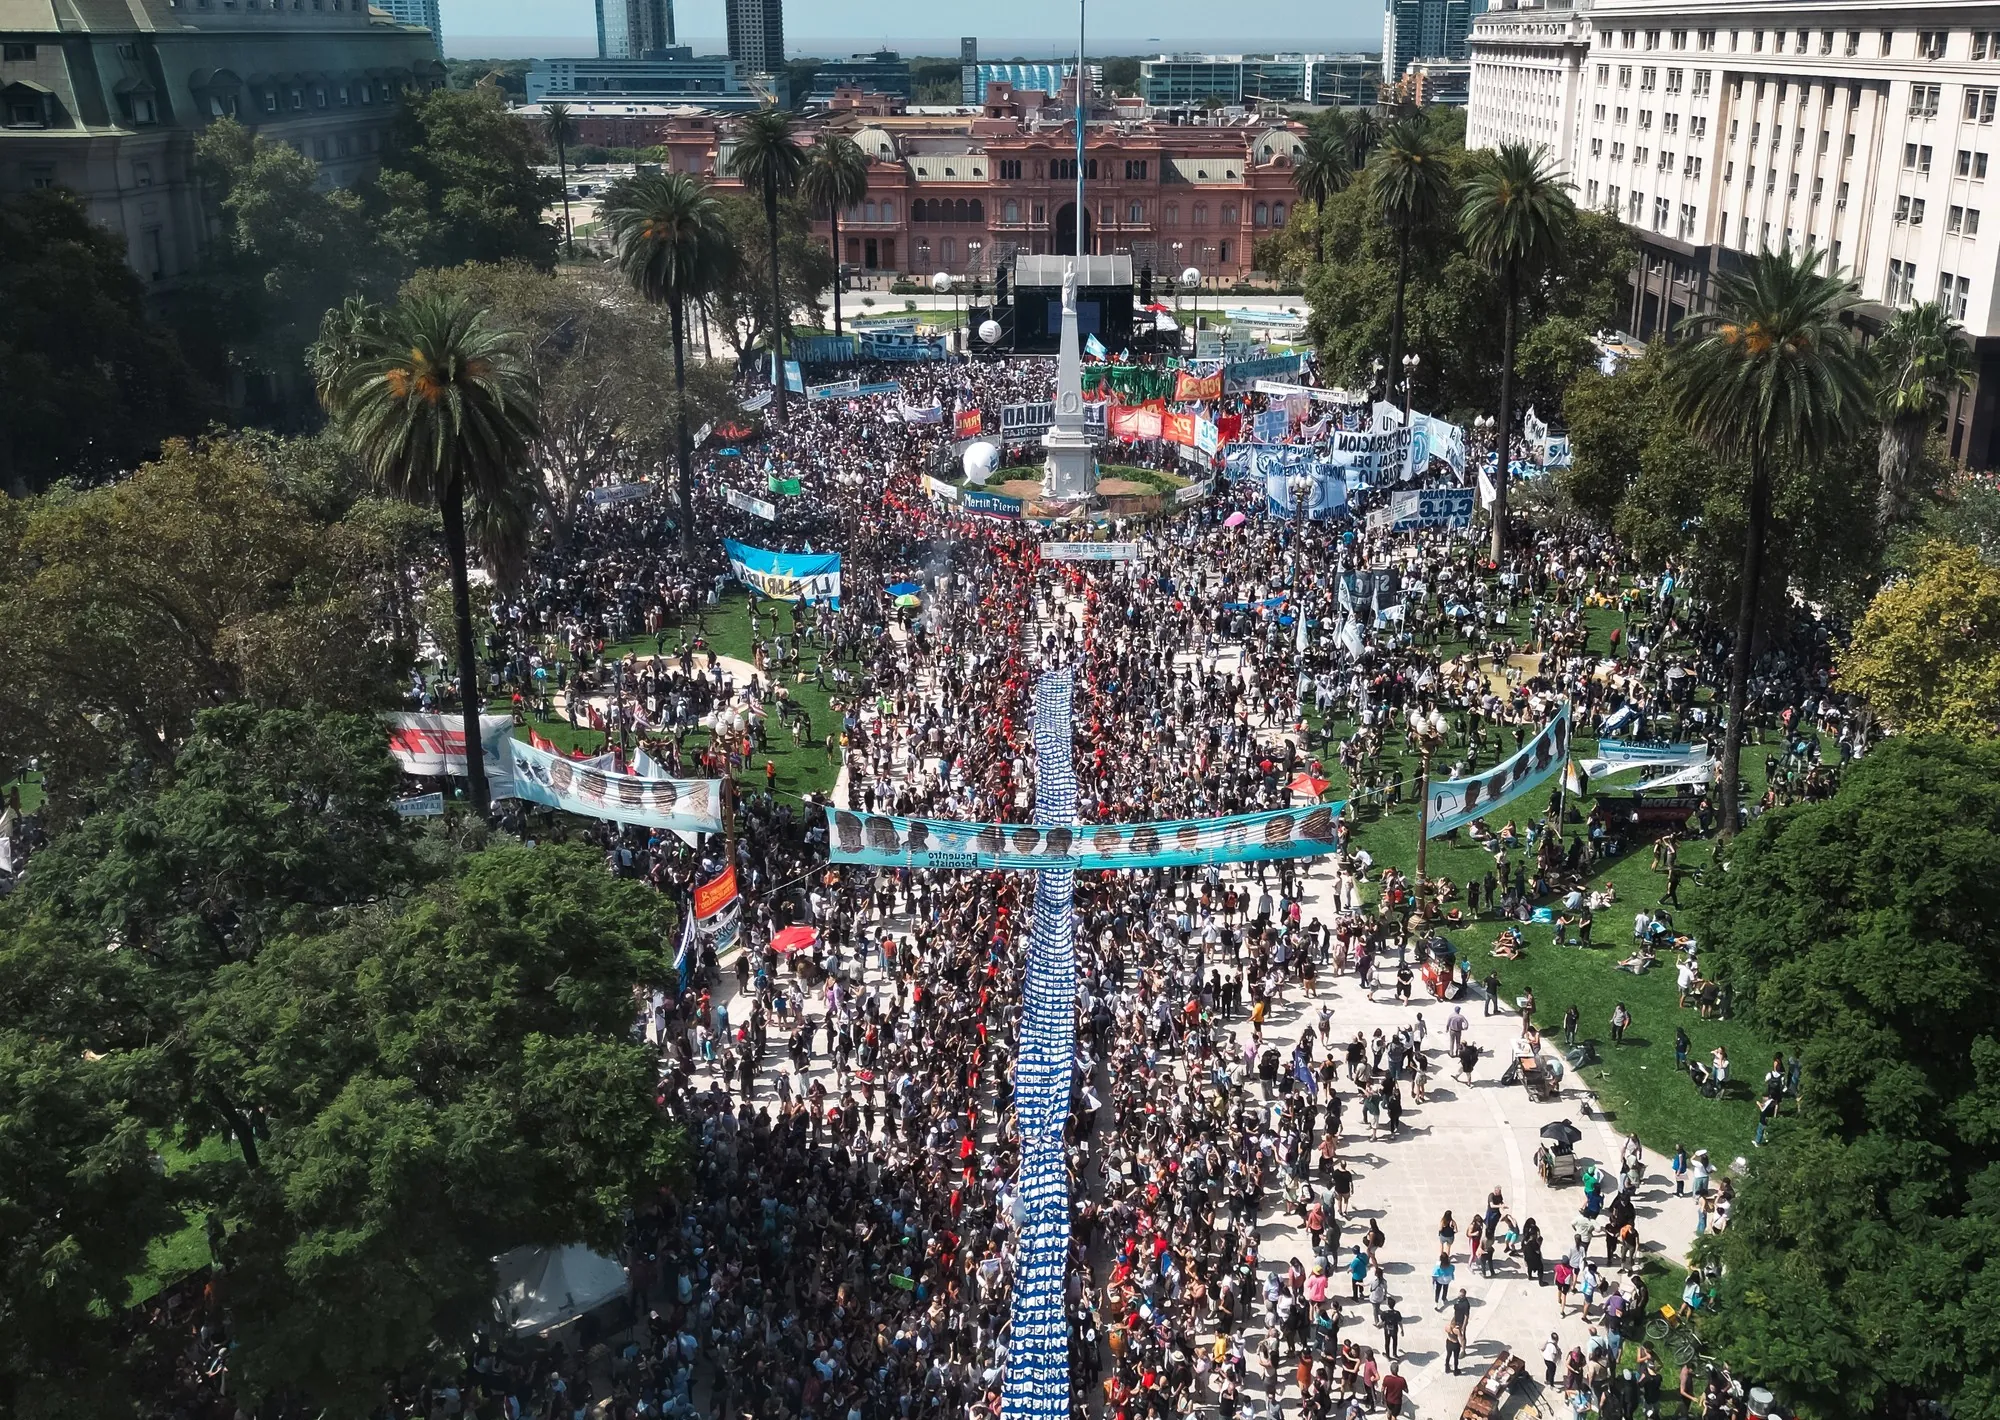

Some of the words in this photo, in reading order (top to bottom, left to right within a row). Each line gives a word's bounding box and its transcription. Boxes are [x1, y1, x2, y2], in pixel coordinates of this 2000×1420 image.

[963, 493, 991, 508] Martin
[991, 497, 1020, 513] Fierro
[1619, 740, 1671, 750] ARGENTINA
[1640, 799, 1697, 809] MOVETE
